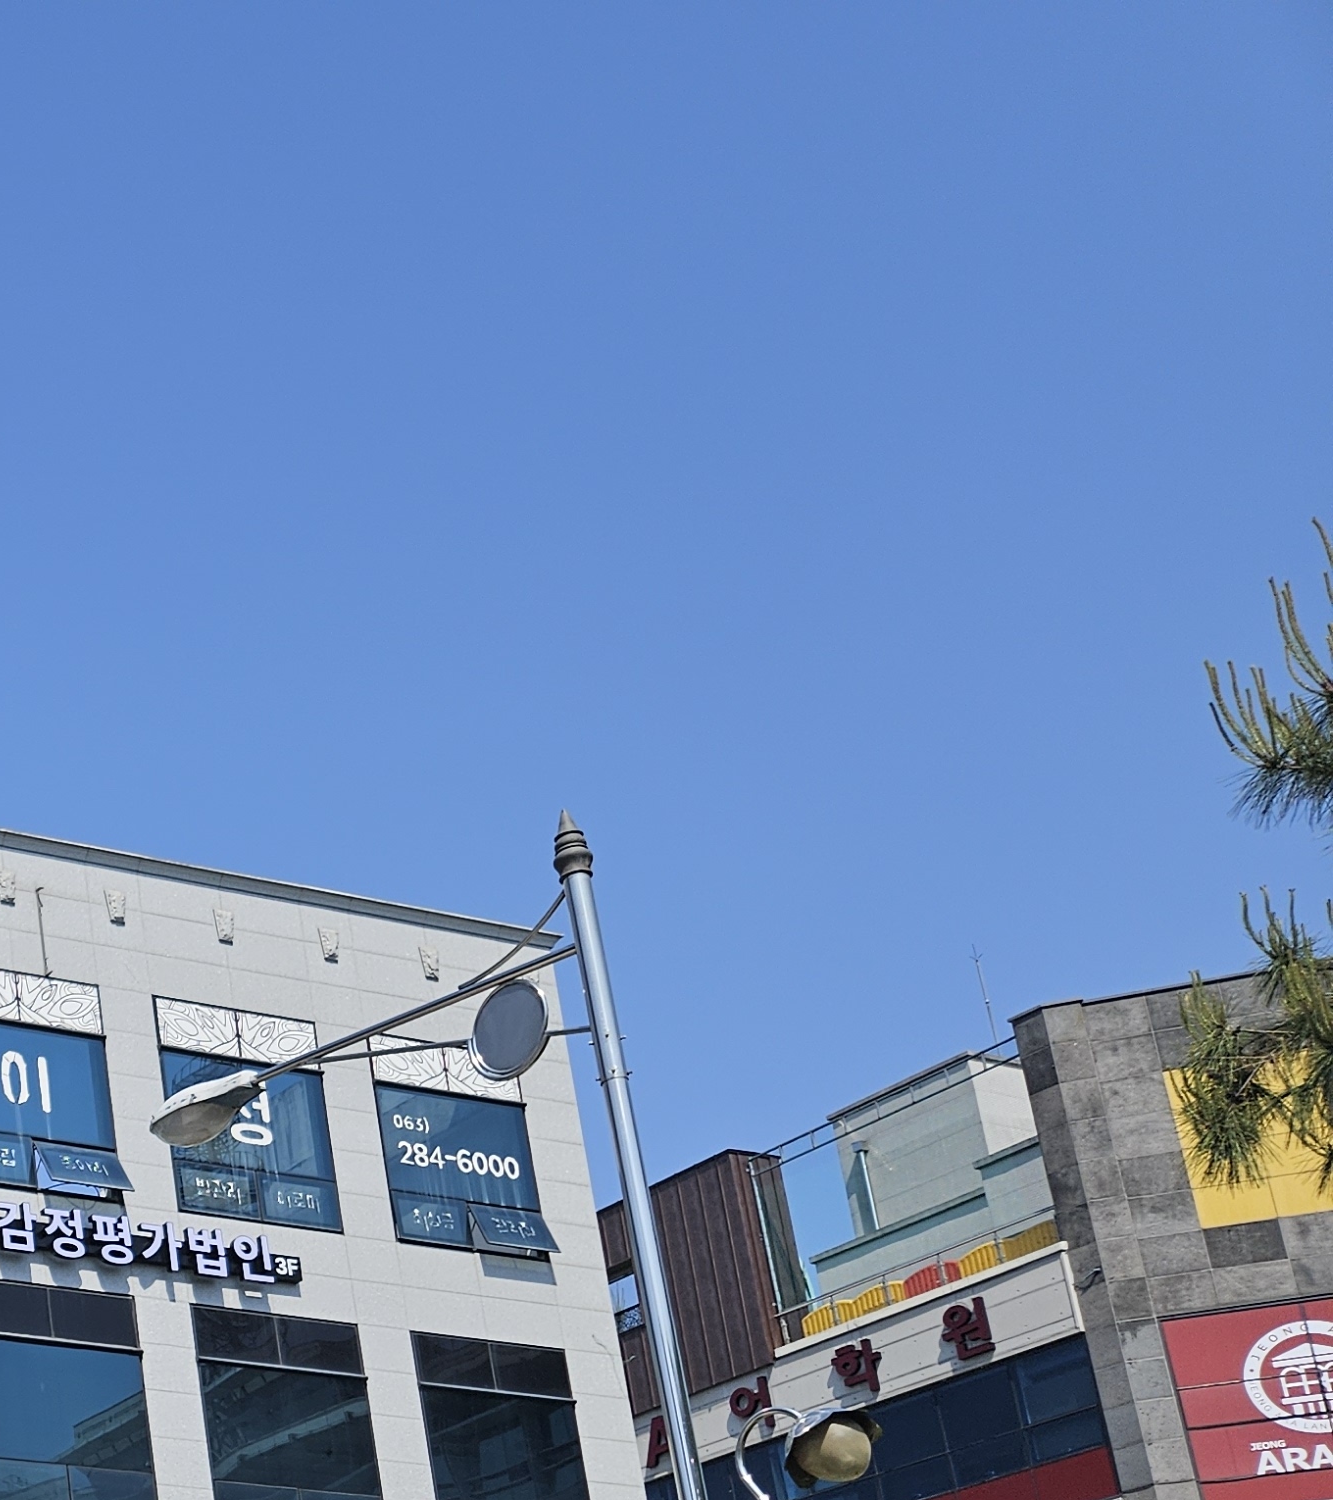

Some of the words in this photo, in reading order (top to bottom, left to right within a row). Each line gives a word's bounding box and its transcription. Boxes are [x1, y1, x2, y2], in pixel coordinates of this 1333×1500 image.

[0, 1050, 52, 1114] 이
[393, 1114, 430, 1133] 063)
[398, 1141, 520, 1180] 284-6000
[274, 1255, 300, 1278] 3F
[1250, 1439, 1286, 1451] JEONG
